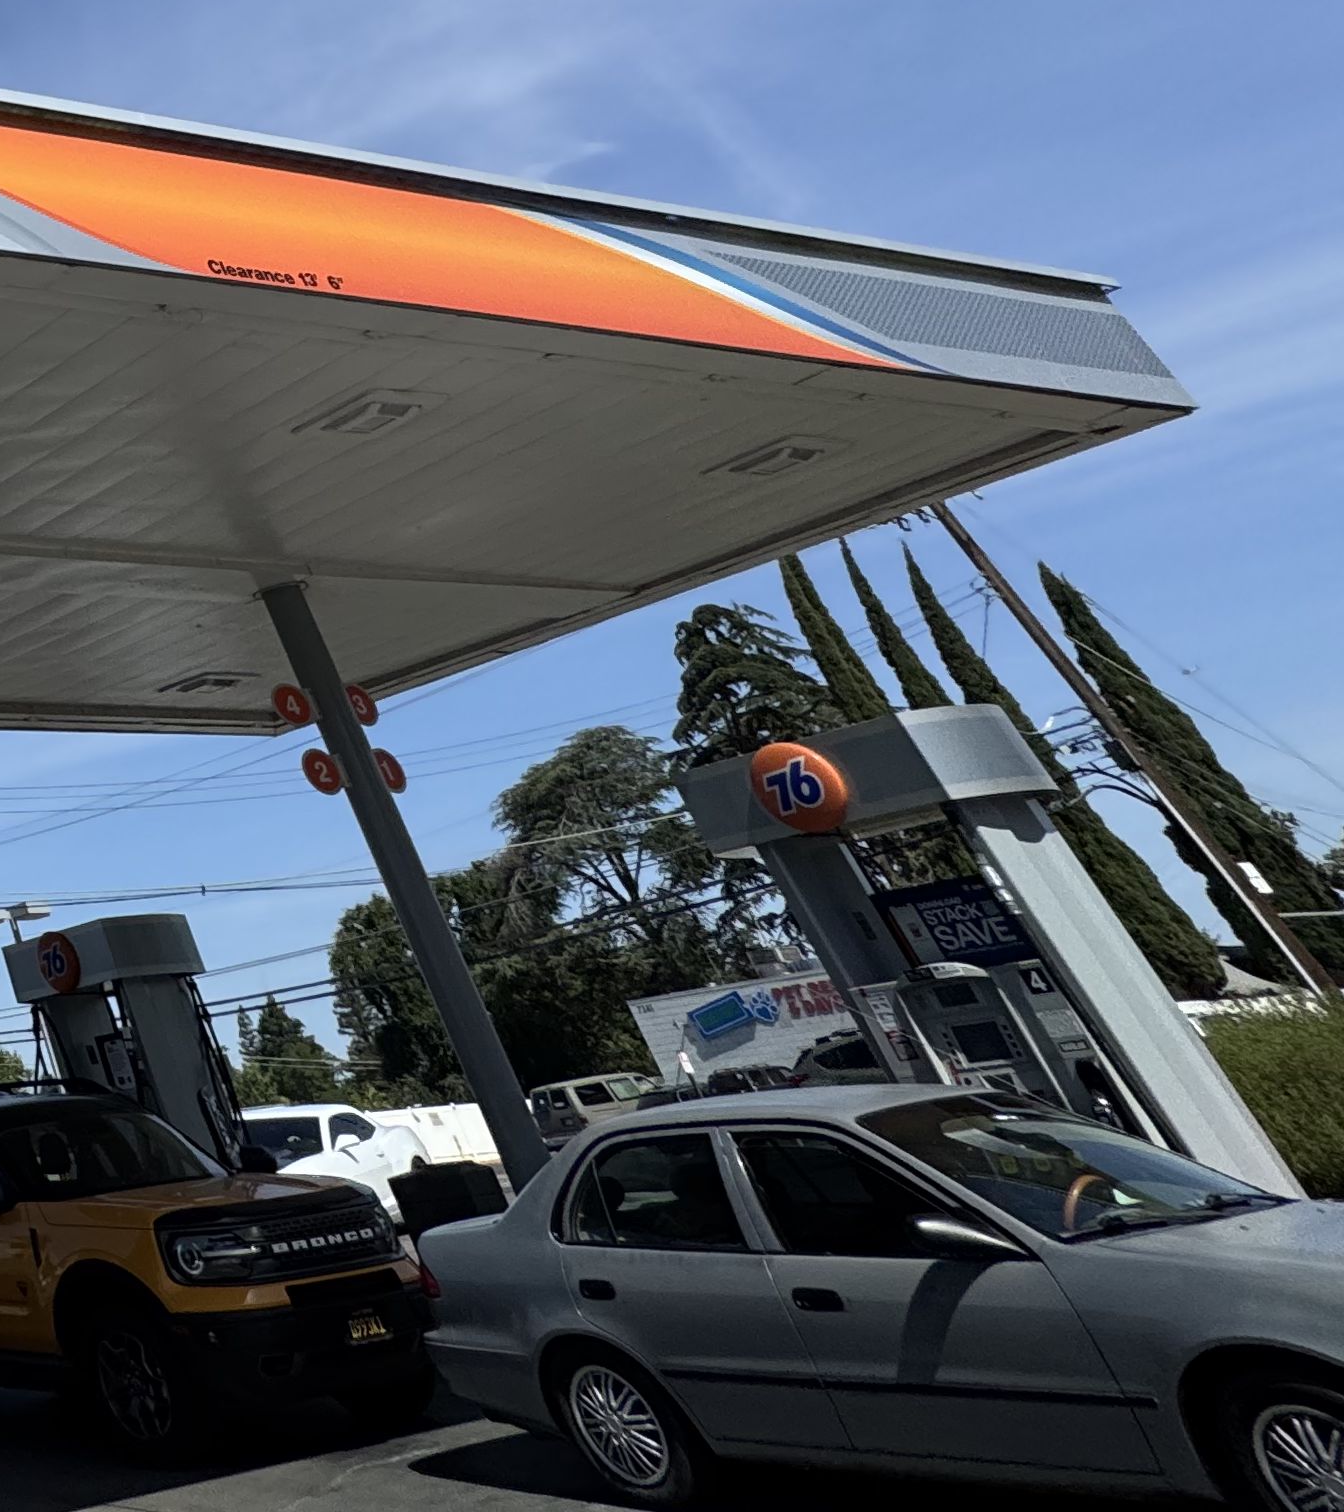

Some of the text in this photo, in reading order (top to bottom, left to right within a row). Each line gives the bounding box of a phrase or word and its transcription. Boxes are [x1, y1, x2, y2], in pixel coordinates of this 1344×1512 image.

[207, 259, 344, 290] Clearance 13' 6"
[286, 695, 301, 715] 4
[352, 694, 368, 715] 3
[314, 761, 332, 783] 2
[380, 760, 395, 781] 1
[762, 755, 826, 817] 76
[922, 902, 983, 926] STACK
[933, 916, 1017, 951] SAVE
[40, 941, 68, 982] 76
[1029, 970, 1048, 992] 4
[271, 1228, 374, 1253] BRONCO
